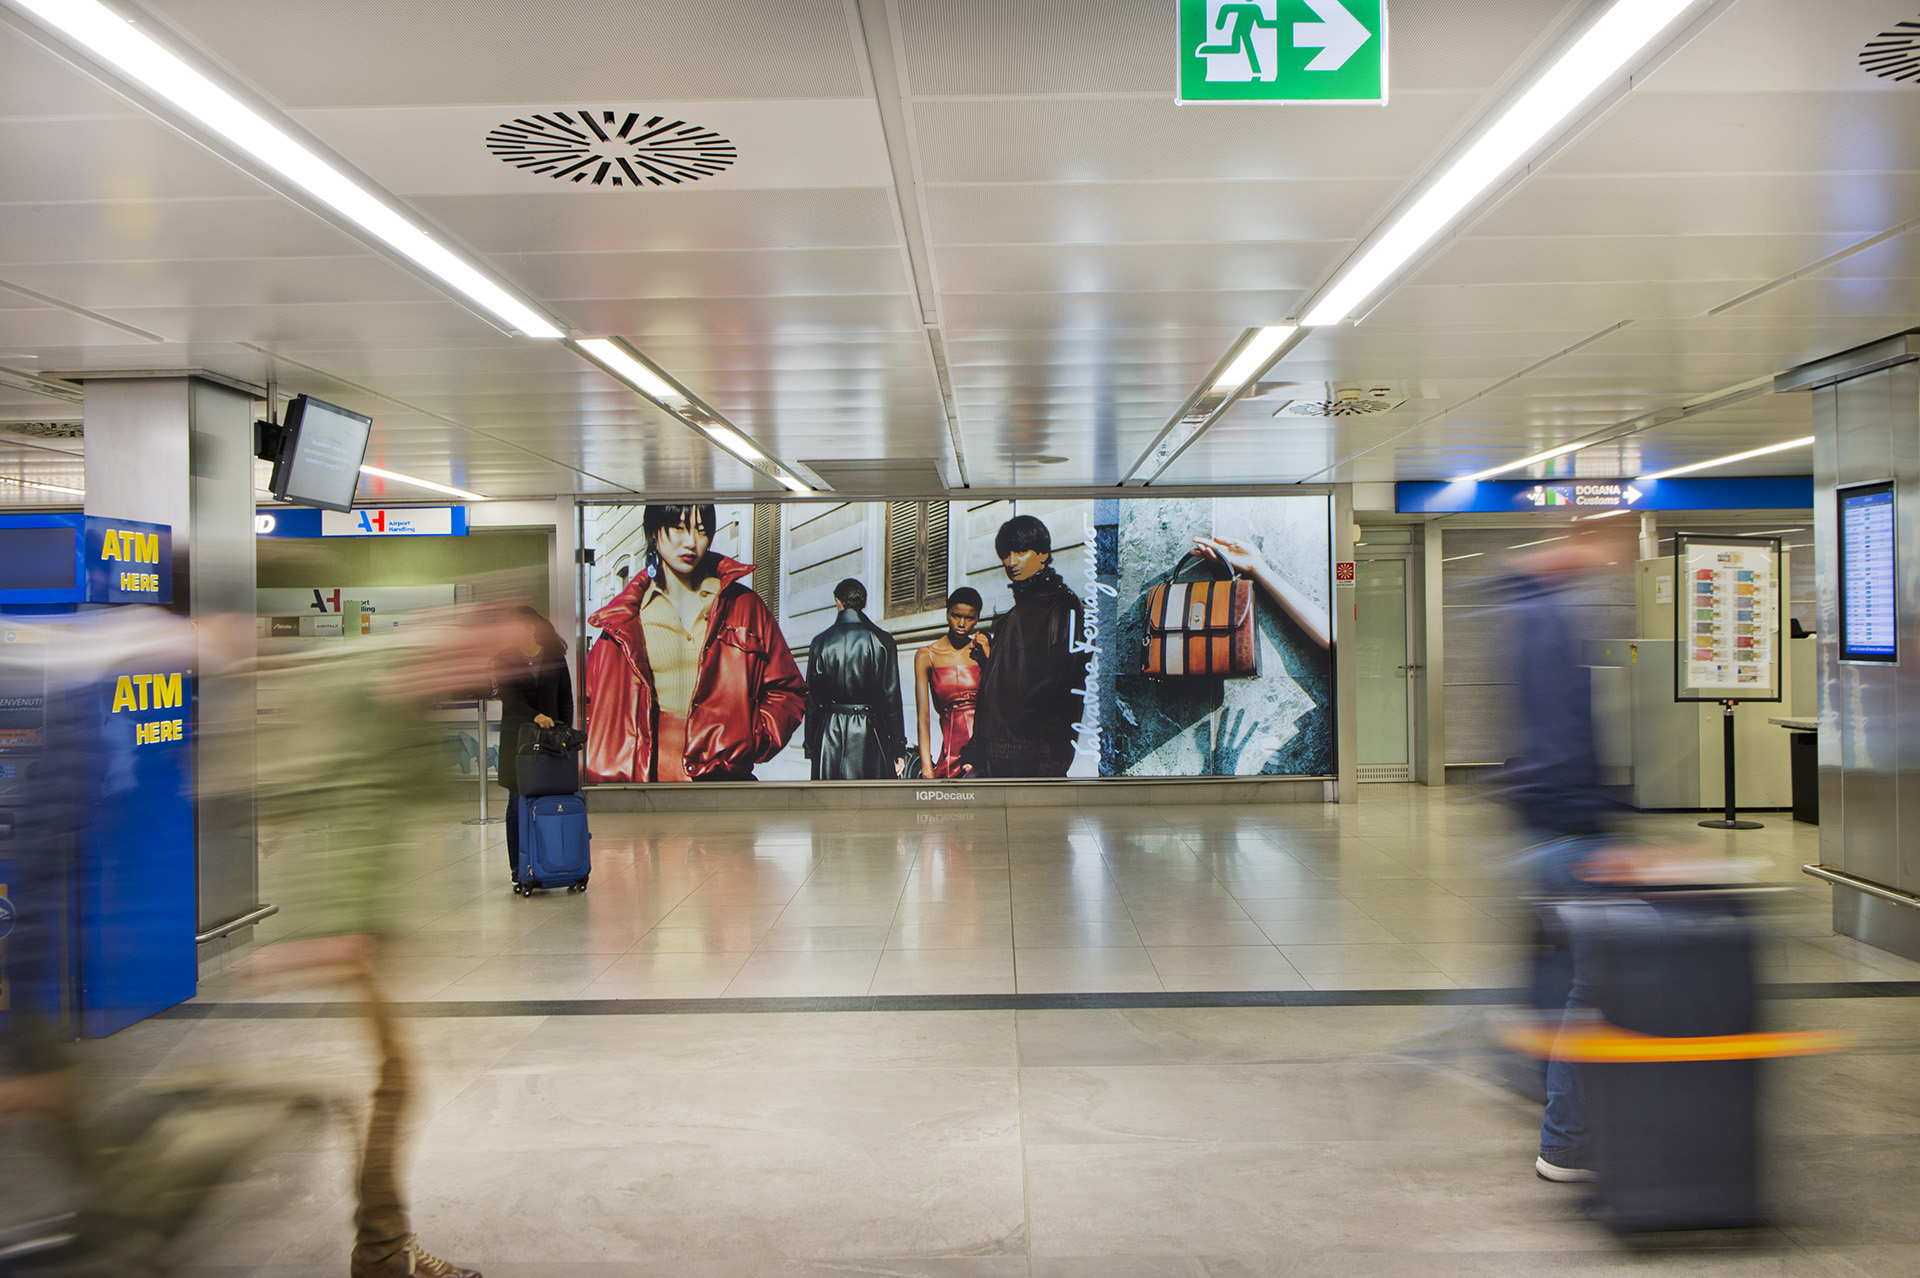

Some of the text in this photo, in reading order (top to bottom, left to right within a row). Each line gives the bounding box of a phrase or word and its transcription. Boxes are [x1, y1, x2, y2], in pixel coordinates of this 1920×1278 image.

[1575, 485, 1621, 495] DOGANA
[1576, 496, 1620, 505] Customs
[101, 529, 159, 564] ATM
[120, 572, 159, 592] HERE
[1069, 512, 1118, 653] Ferragamo
[0, 698, 43, 706] ENVENUTI
[111, 672, 183, 713] ATM
[136, 719, 183, 745] HERE
[915, 791, 976, 801] IGPDecaux
